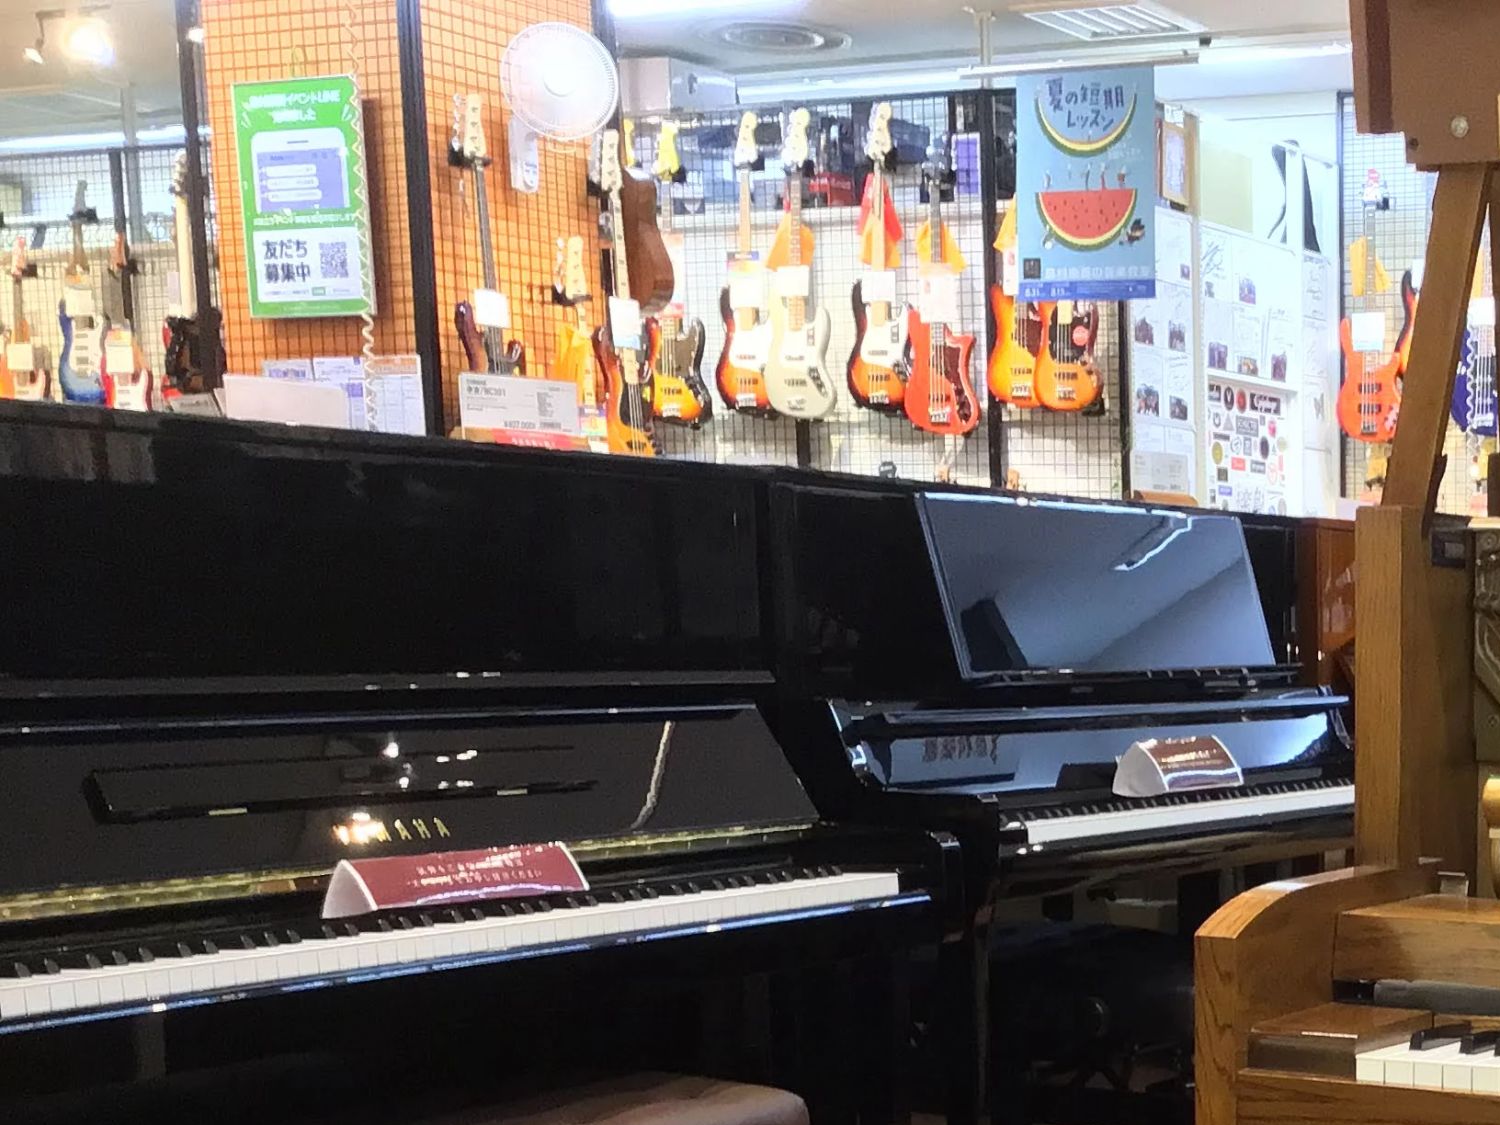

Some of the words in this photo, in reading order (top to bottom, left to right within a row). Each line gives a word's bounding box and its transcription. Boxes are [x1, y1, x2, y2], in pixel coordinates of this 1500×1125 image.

[1045, 76, 1125, 113] 夏の短期
[1066, 109, 1115, 132] レッスン
[262, 239, 309, 260] 友だち
[264, 261, 311, 284] 募集中
[332, 816, 451, 844] MAHA
